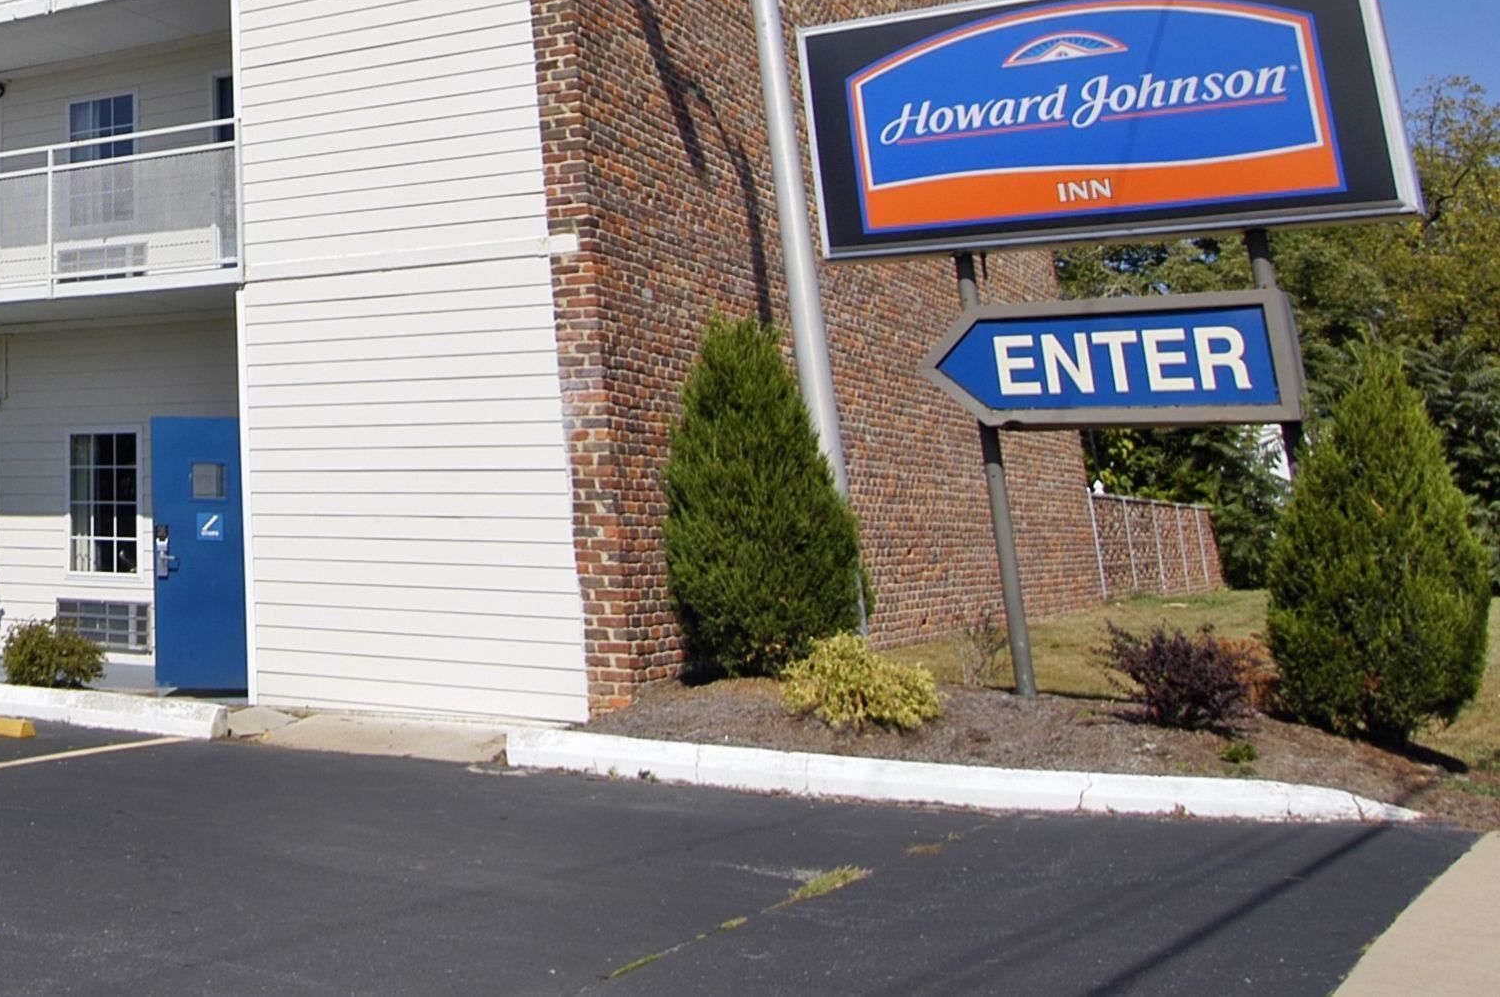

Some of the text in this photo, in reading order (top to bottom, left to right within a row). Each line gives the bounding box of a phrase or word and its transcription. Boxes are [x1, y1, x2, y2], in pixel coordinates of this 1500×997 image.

[880, 64, 1287, 146] Howard Johnson
[1057, 177, 1113, 204] INN
[993, 326, 1253, 395] ENTER
